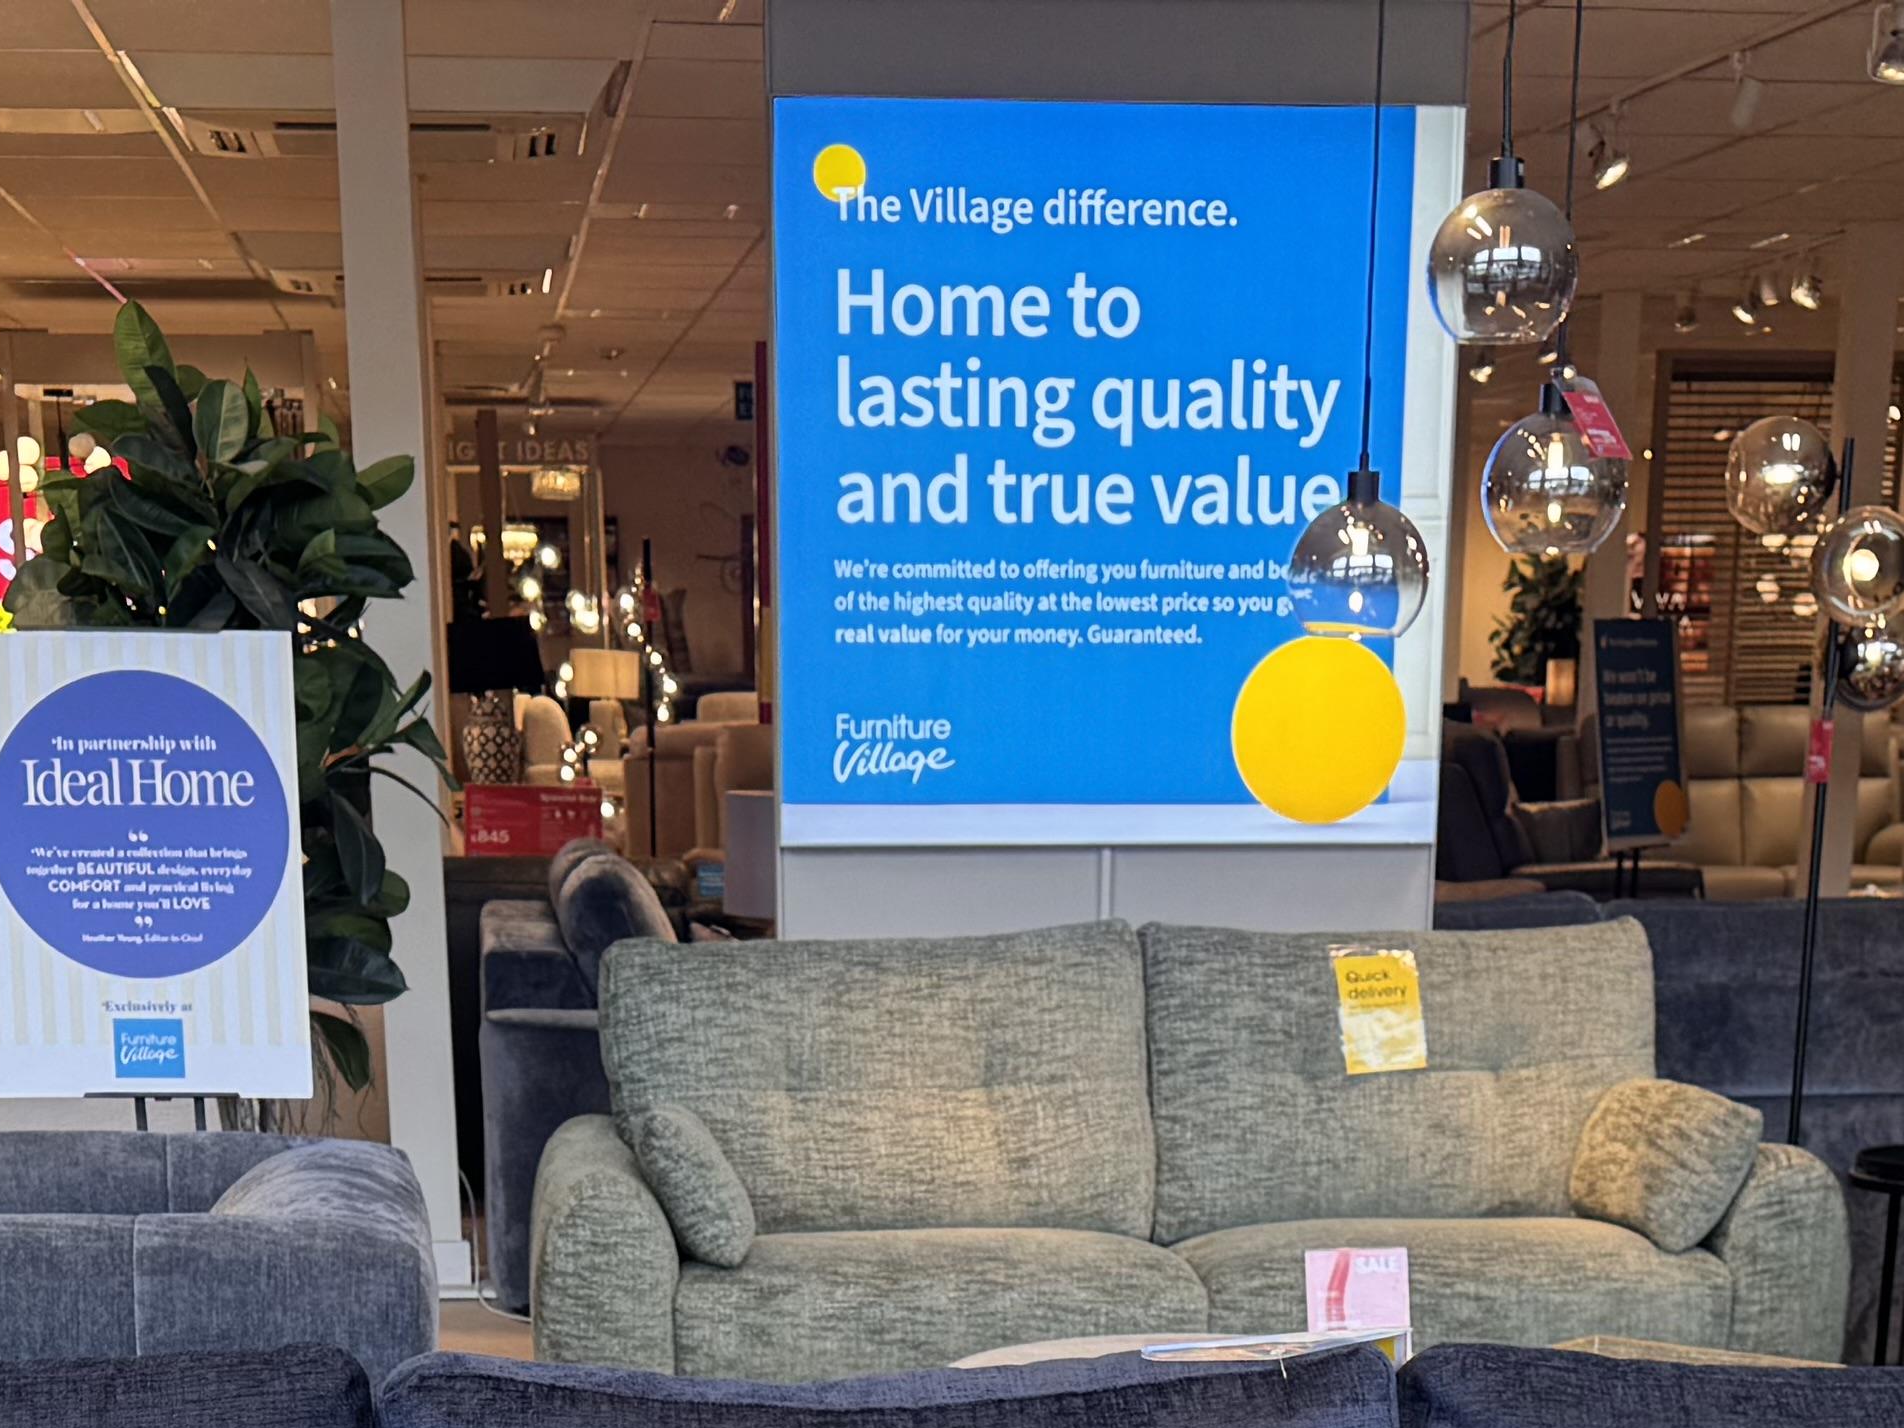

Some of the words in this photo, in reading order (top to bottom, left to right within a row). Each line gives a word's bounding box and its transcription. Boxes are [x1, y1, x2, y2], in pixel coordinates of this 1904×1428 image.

[837, 186, 901, 223] The
[911, 188, 1033, 233] Village
[1043, 189, 1238, 227] difference.
[837, 269, 1050, 337] Home
[1068, 273, 1141, 338] to
[837, 356, 1075, 447] lasting
[1092, 358, 1340, 447] quality
[516, 440, 589, 461] IDEAS
[837, 454, 968, 526] and
[987, 460, 1134, 527] true
[834, 559, 888, 579] We're
[892, 558, 996, 579] committed
[999, 560, 1020, 579] to
[1023, 558, 1097, 584] offering
[1102, 562, 1136, 584] you
[1140, 559, 1224, 580] furniture
[1228, 560, 1264, 580] and
[834, 591, 854, 611] of
[858, 591, 889, 611] the
[893, 590, 964, 616] highest
[967, 591, 1034, 616] quality
[1038, 593, 1057, 611] at
[1061, 591, 1092, 611] the
[1096, 592, 1157, 612] lowest
[1162, 592, 1208, 616] price
[1212, 597, 1234, 612] so
[1238, 597, 1273, 616] you
[835, 624, 875, 643] real
[878, 624, 932, 643] value
[936, 623, 963, 643] for
[967, 628, 1011, 648] your
[1014, 628, 1083, 648] money.
[1087, 624, 1203, 644] Guaranteed.
[836, 713, 951, 741] Furniture
[78, 737, 177, 755] partnership
[180, 736, 217, 752] with
[833, 742, 956, 785] Village
[21, 757, 127, 807] Ideal
[128, 759, 256, 807] Home
[77, 862, 155, 875] BEAUTIFUL
[48, 879, 121, 893] COMFORT
[173, 897, 211, 909] LOVE
[1346, 970, 1391, 984] Quick
[1347, 984, 1407, 1001] delivery
[102, 1001, 177, 1014] Exclusively
[120, 1032, 178, 1046] Furniture
[120, 1047, 180, 1065] Village
